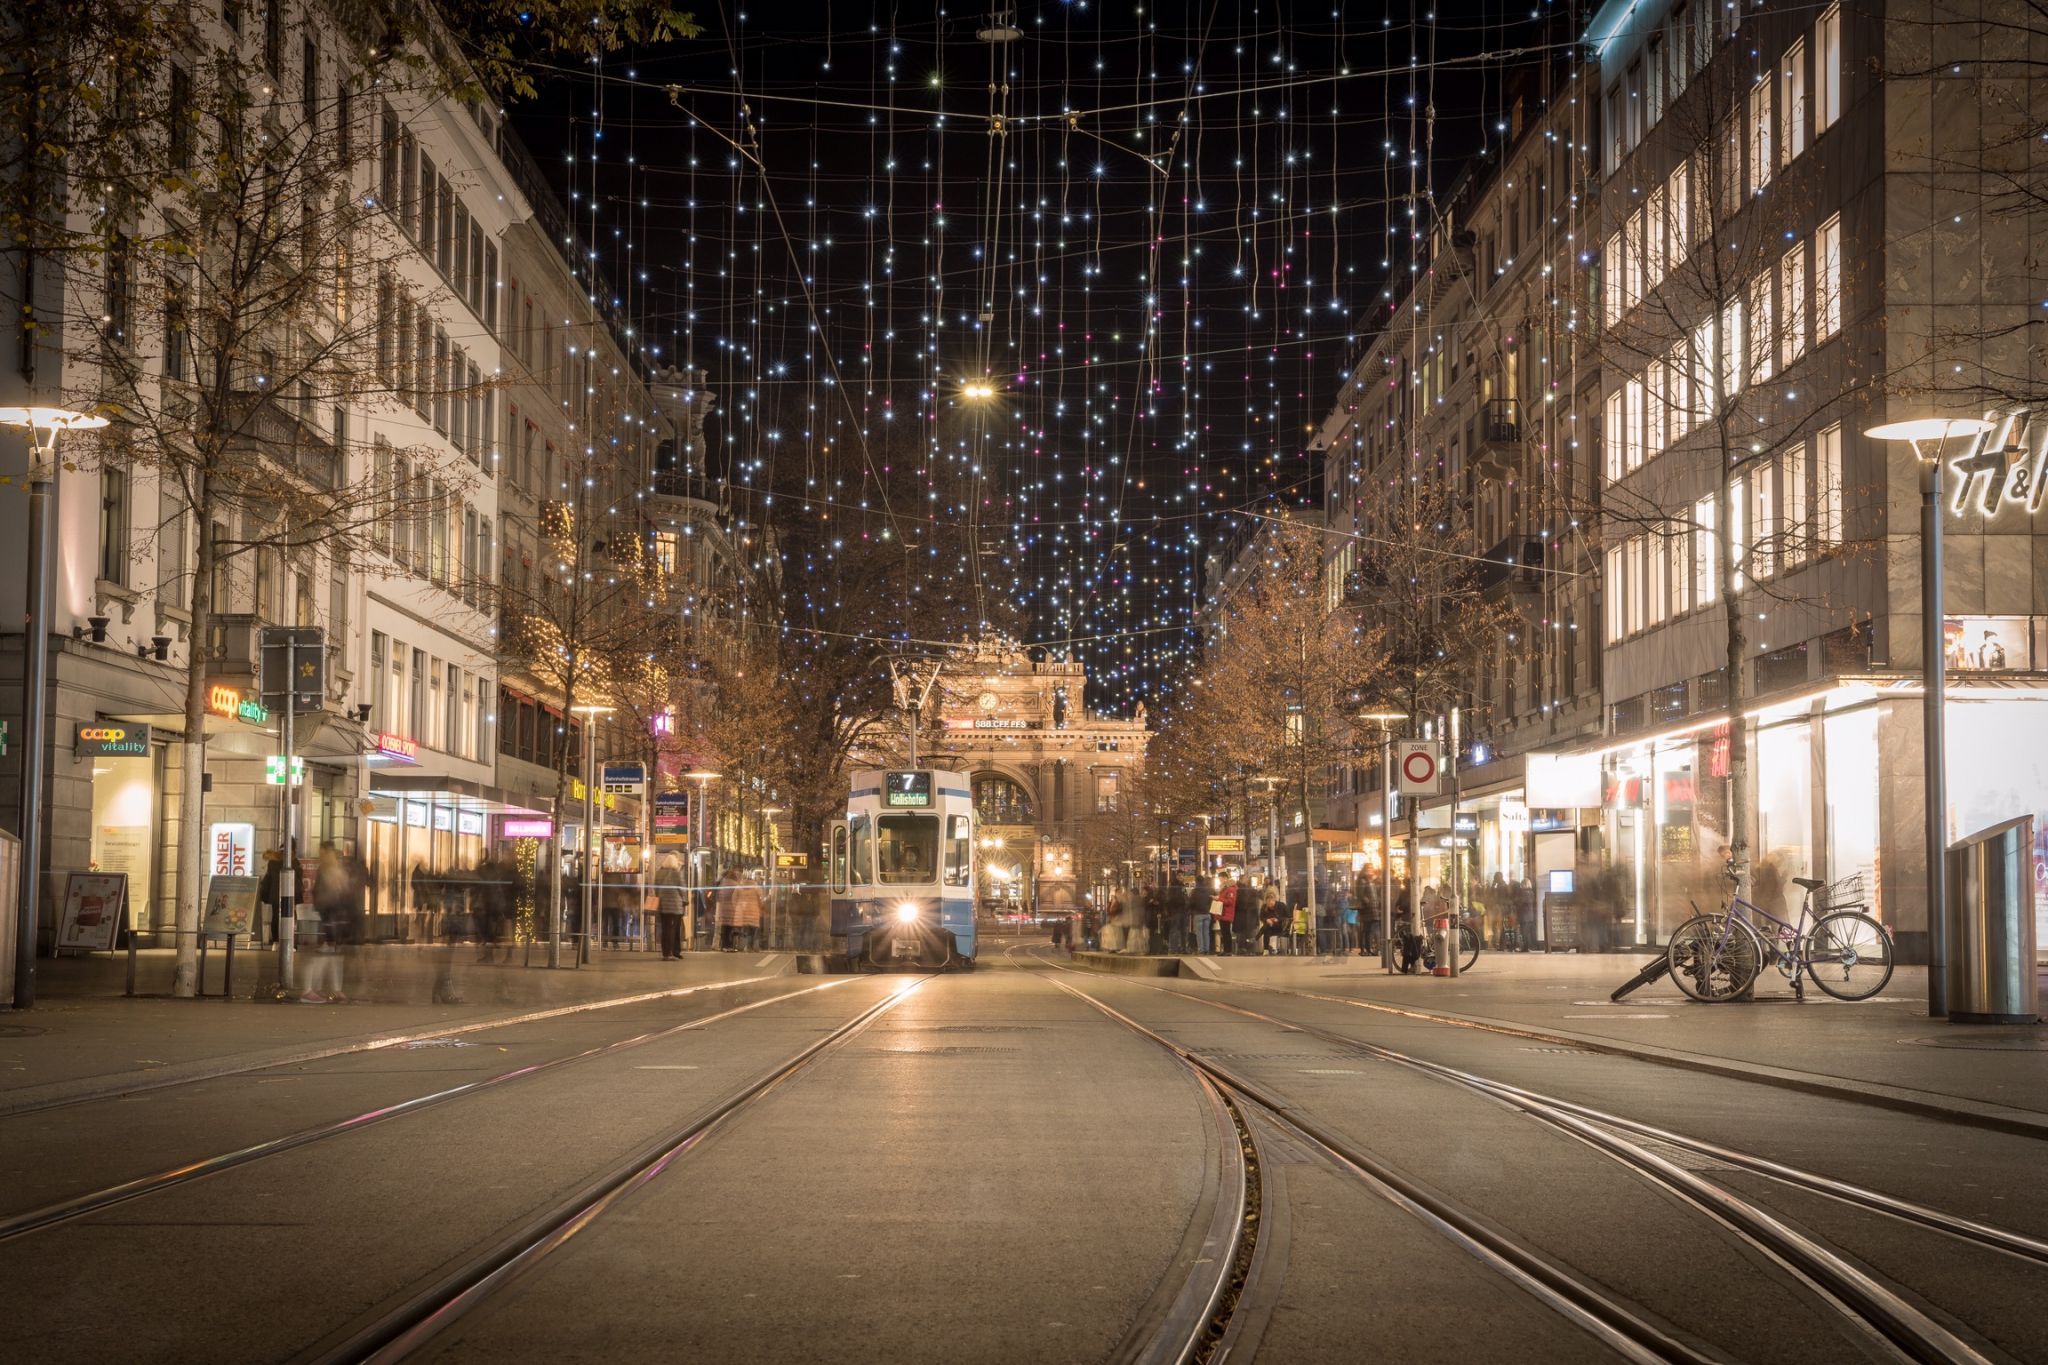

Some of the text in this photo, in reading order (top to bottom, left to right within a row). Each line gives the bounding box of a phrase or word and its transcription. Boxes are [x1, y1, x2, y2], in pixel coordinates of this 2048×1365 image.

[211, 686, 239, 720] coop
[238, 700, 261, 723] vitality
[975, 720, 991, 728] SBB
[994, 720, 1009, 728] CFF
[80, 728, 125, 743] coop
[101, 742, 146, 753] vitality
[902, 774, 915, 790] 7
[889, 793, 928, 805] Wollishofen
[216, 832, 230, 876] SNER
[232, 844, 246, 877] ORT
